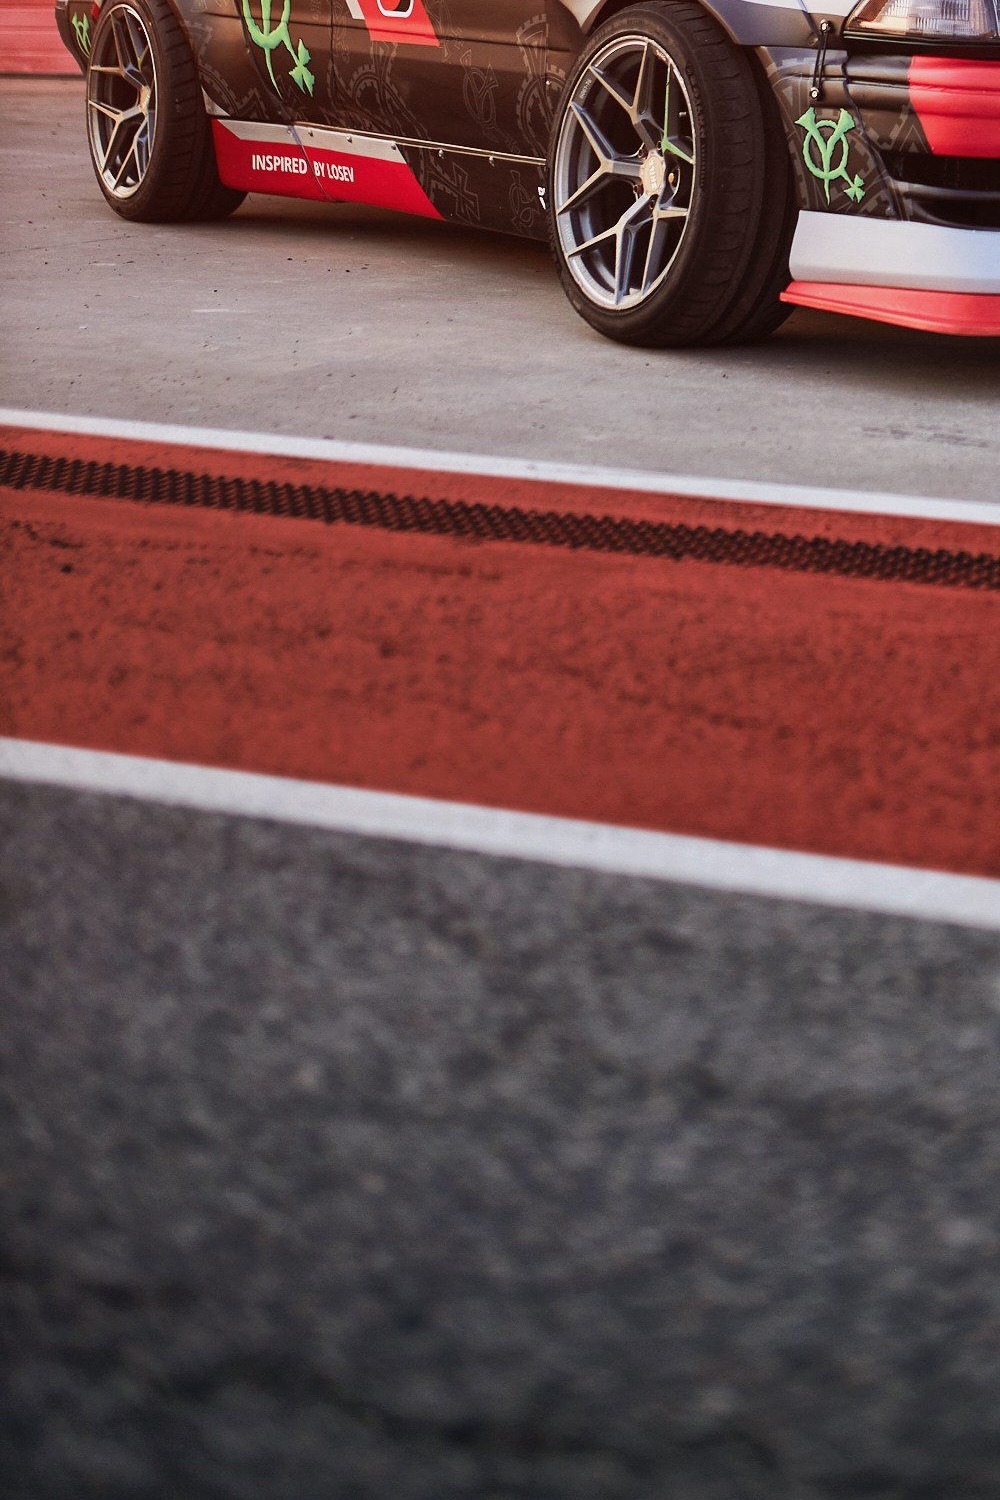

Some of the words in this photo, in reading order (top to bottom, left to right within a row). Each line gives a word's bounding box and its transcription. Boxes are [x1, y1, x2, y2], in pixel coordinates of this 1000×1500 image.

[252, 154, 308, 175] INSPIRED
[313, 160, 325, 177] BY
[327, 163, 354, 183] LOSEV
